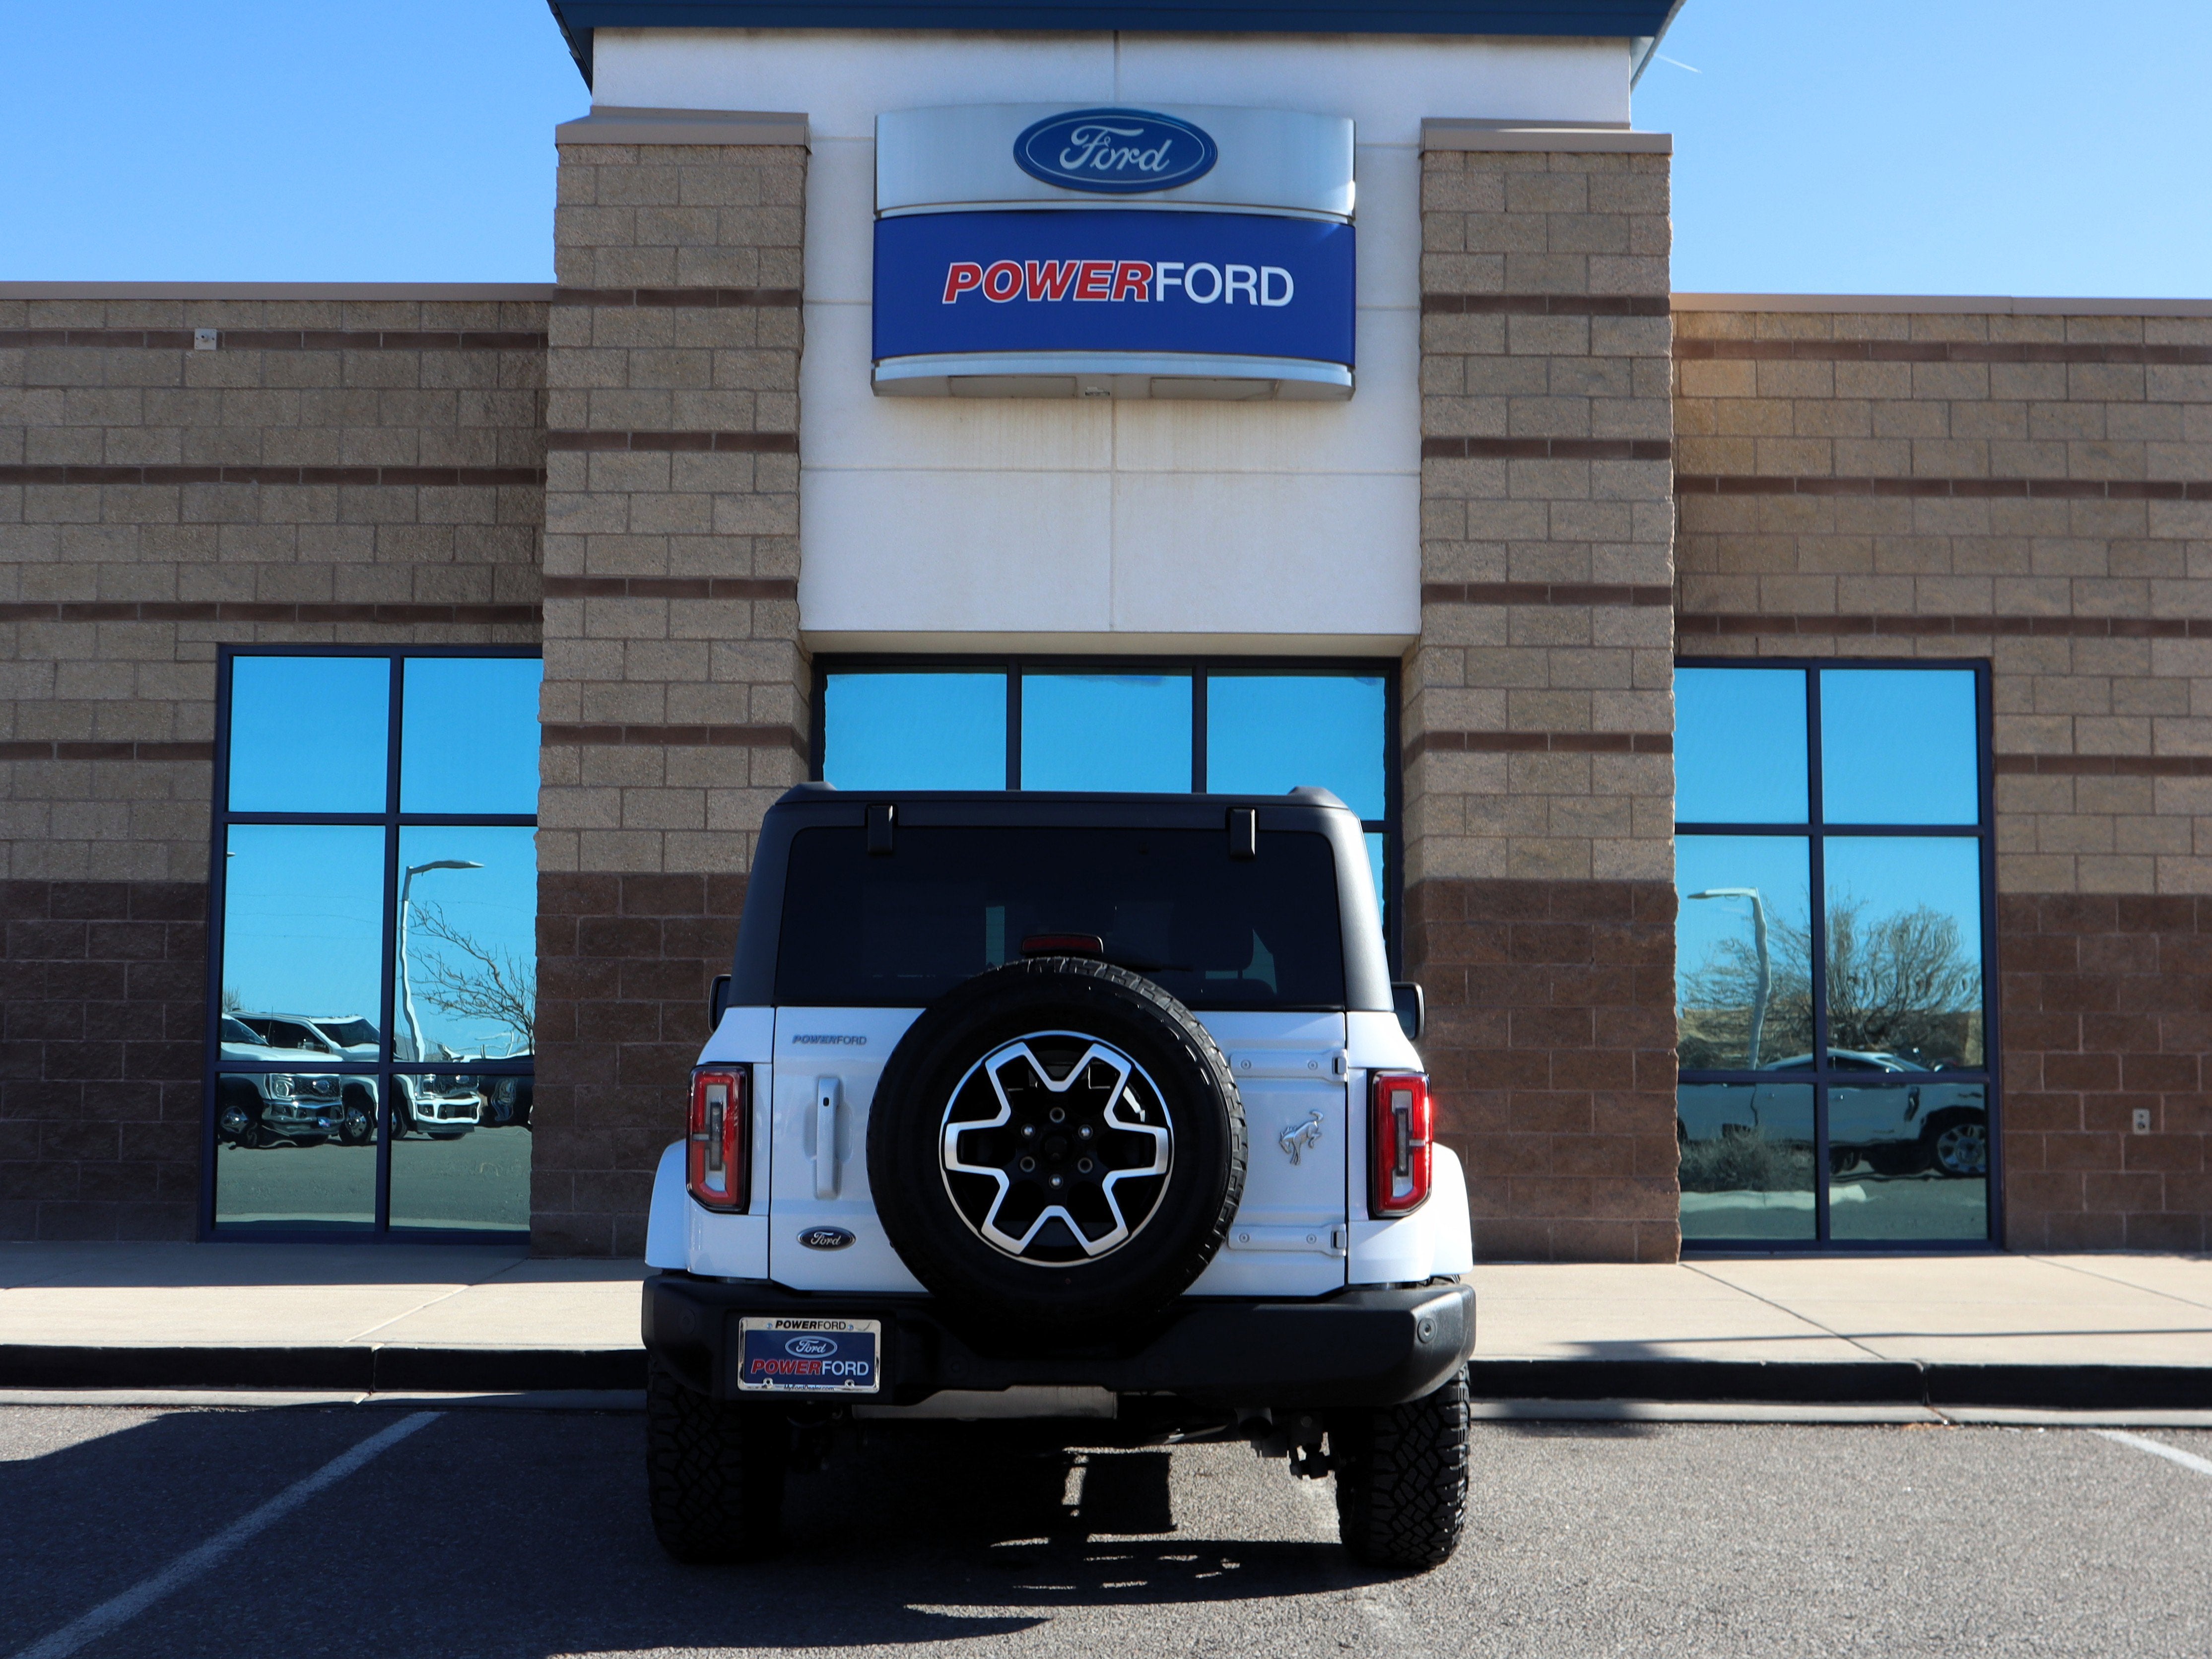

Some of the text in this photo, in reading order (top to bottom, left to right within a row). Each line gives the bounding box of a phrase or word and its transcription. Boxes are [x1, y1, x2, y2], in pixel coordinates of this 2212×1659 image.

[1058, 124, 1173, 173] Ford
[942, 260, 1294, 307] POWERFORD
[810, 1232, 841, 1245] Ford
[775, 1320, 846, 1330] POWERFORD
[796, 1339, 826, 1354] Ford
[751, 1359, 869, 1376] POWERFORD
